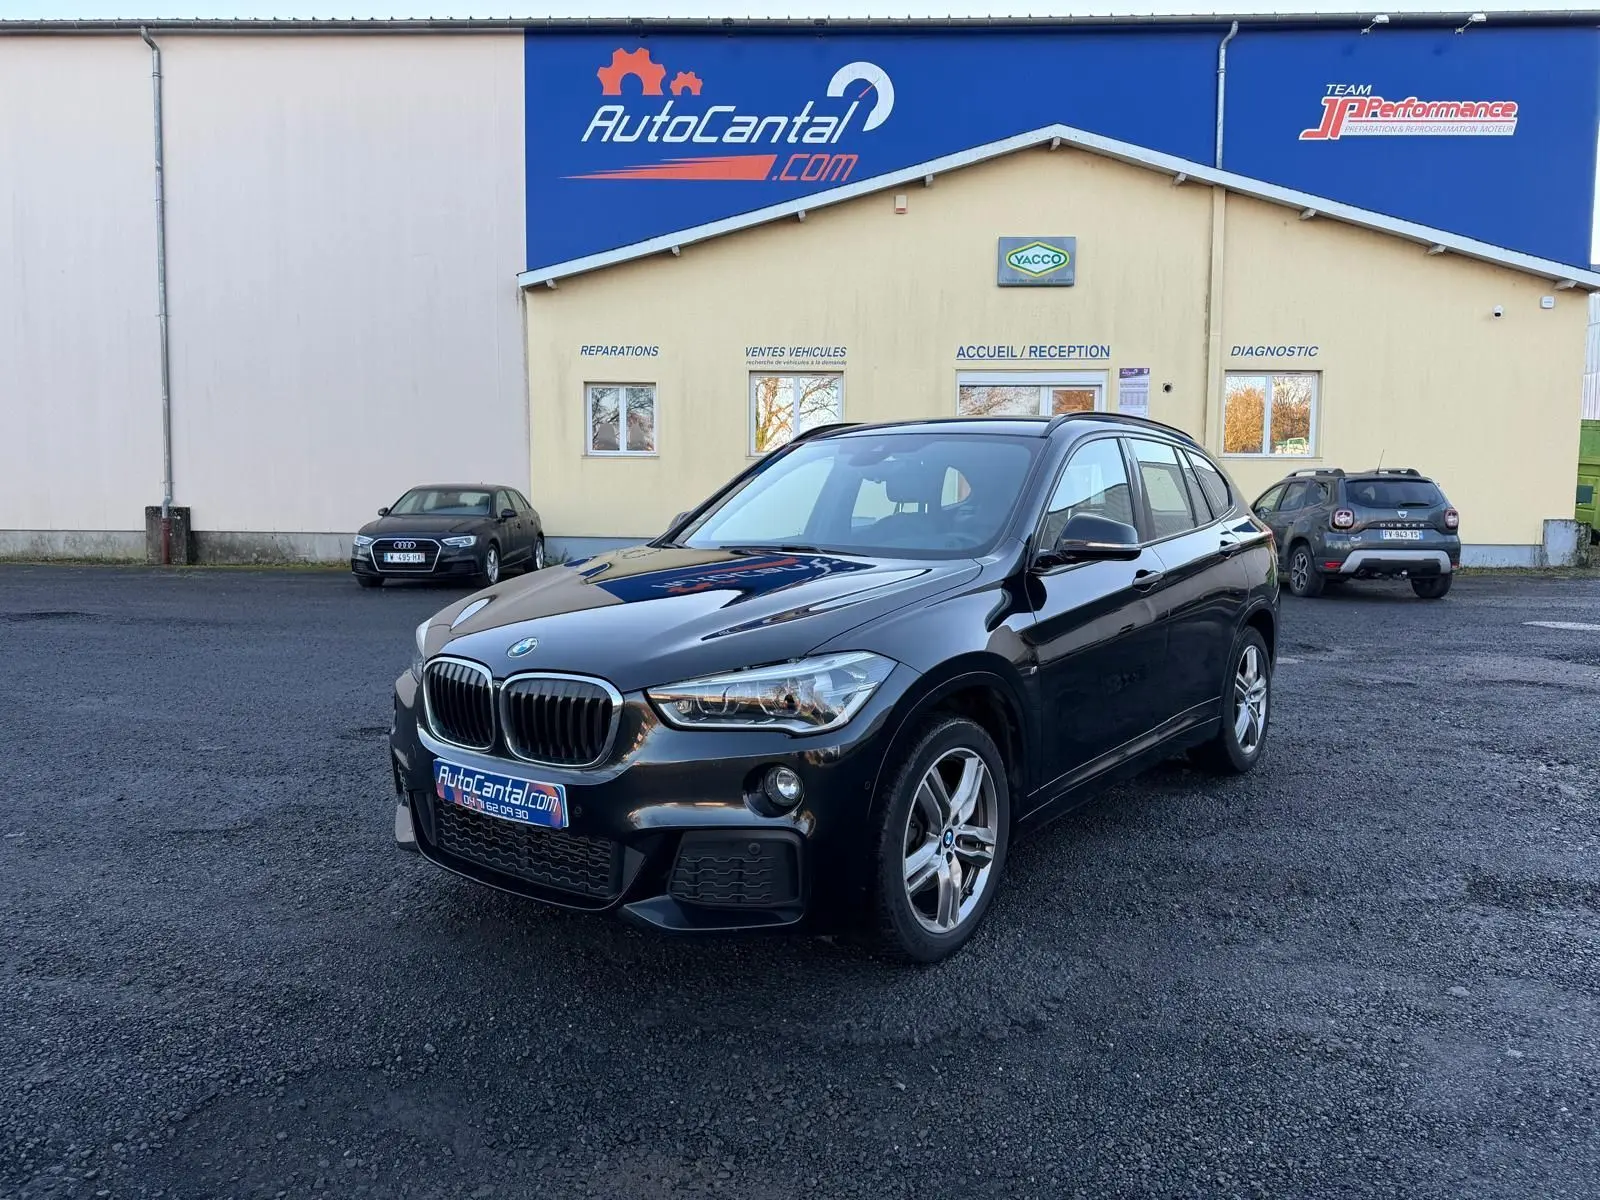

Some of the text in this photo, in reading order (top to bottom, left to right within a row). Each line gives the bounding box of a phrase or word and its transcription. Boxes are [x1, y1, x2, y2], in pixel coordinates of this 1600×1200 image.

[1326, 83, 1372, 96] TEAM
[581, 100, 860, 144] AutoCantal
[1344, 125, 1397, 133] PREPARATION
[1405, 125, 1477, 133] REPROGRAMATION
[1480, 125, 1514, 133] MOTEUR
[1014, 254, 1062, 265] YACCO
[580, 345, 659, 357] REPARATIONS
[745, 346, 847, 358] VENTES VEHICULES
[956, 345, 1018, 358] ACCUEIL
[1029, 345, 1110, 358] RECEPTION
[1230, 346, 1320, 357] DIAGNOSTIC
[438, 765, 559, 813] AutoCantal.com
[463, 794, 476, 805] 04
[486, 801, 498, 813] 62
[500, 804, 514, 816] 09
[515, 808, 529, 820] 30
